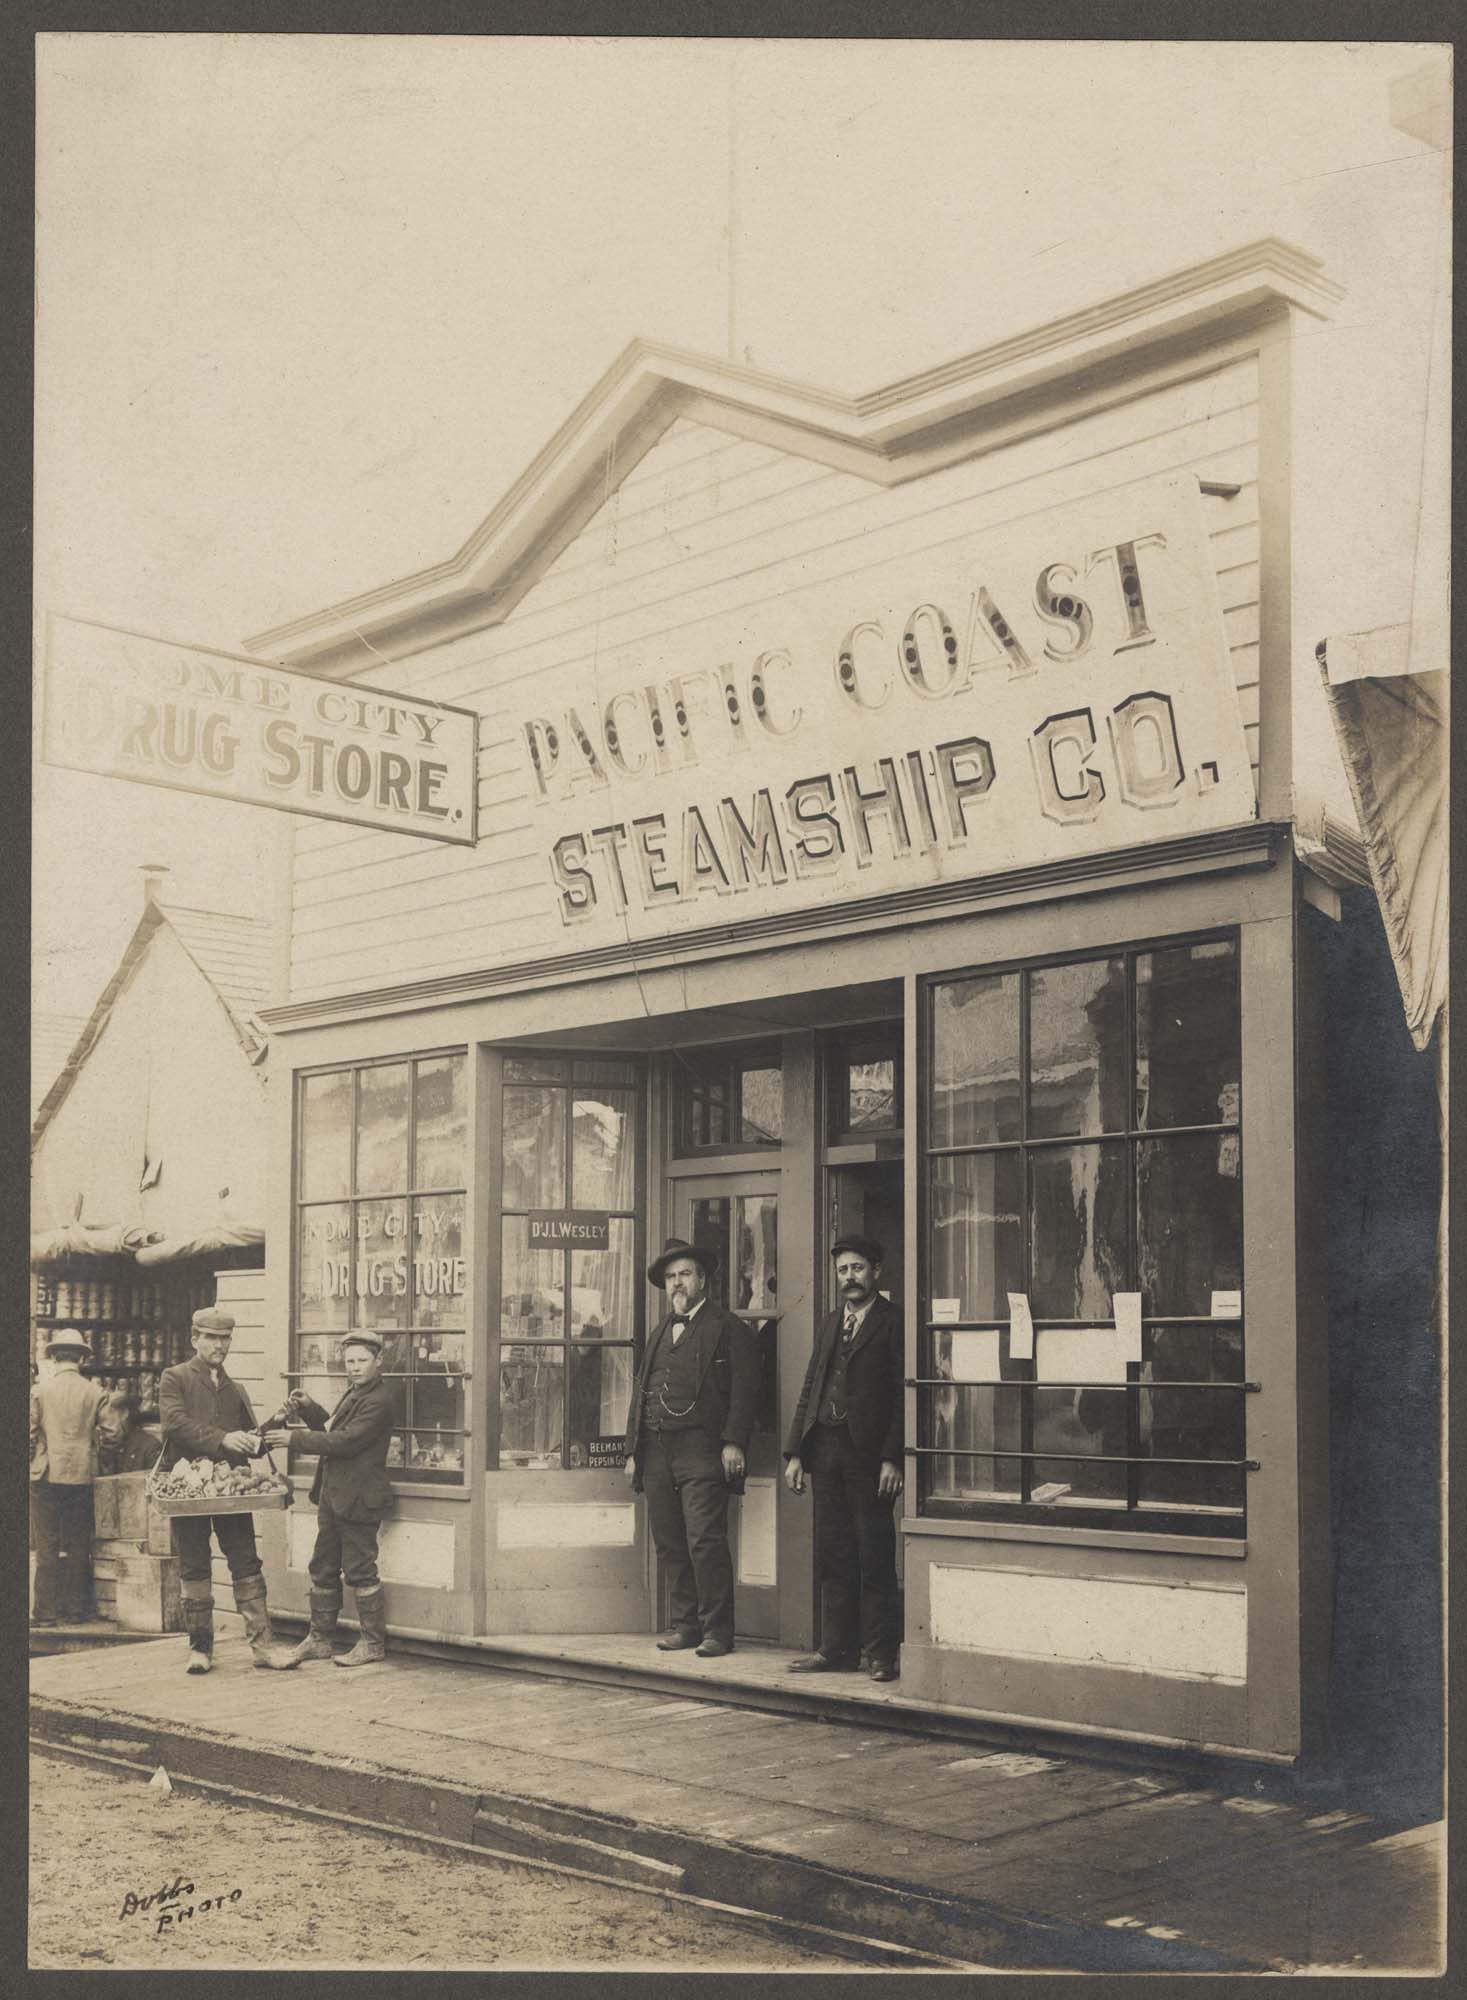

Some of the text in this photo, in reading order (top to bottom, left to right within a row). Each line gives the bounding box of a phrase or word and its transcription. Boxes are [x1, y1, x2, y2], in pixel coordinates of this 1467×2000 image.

[315, 690, 447, 748] CITY
[521, 532, 1168, 805] PACIFIC COAST
[262, 719, 464, 824] STORE.
[550, 691, 1220, 927] STEAMSHIP CO.
[384, 1210, 445, 1239] CITY
